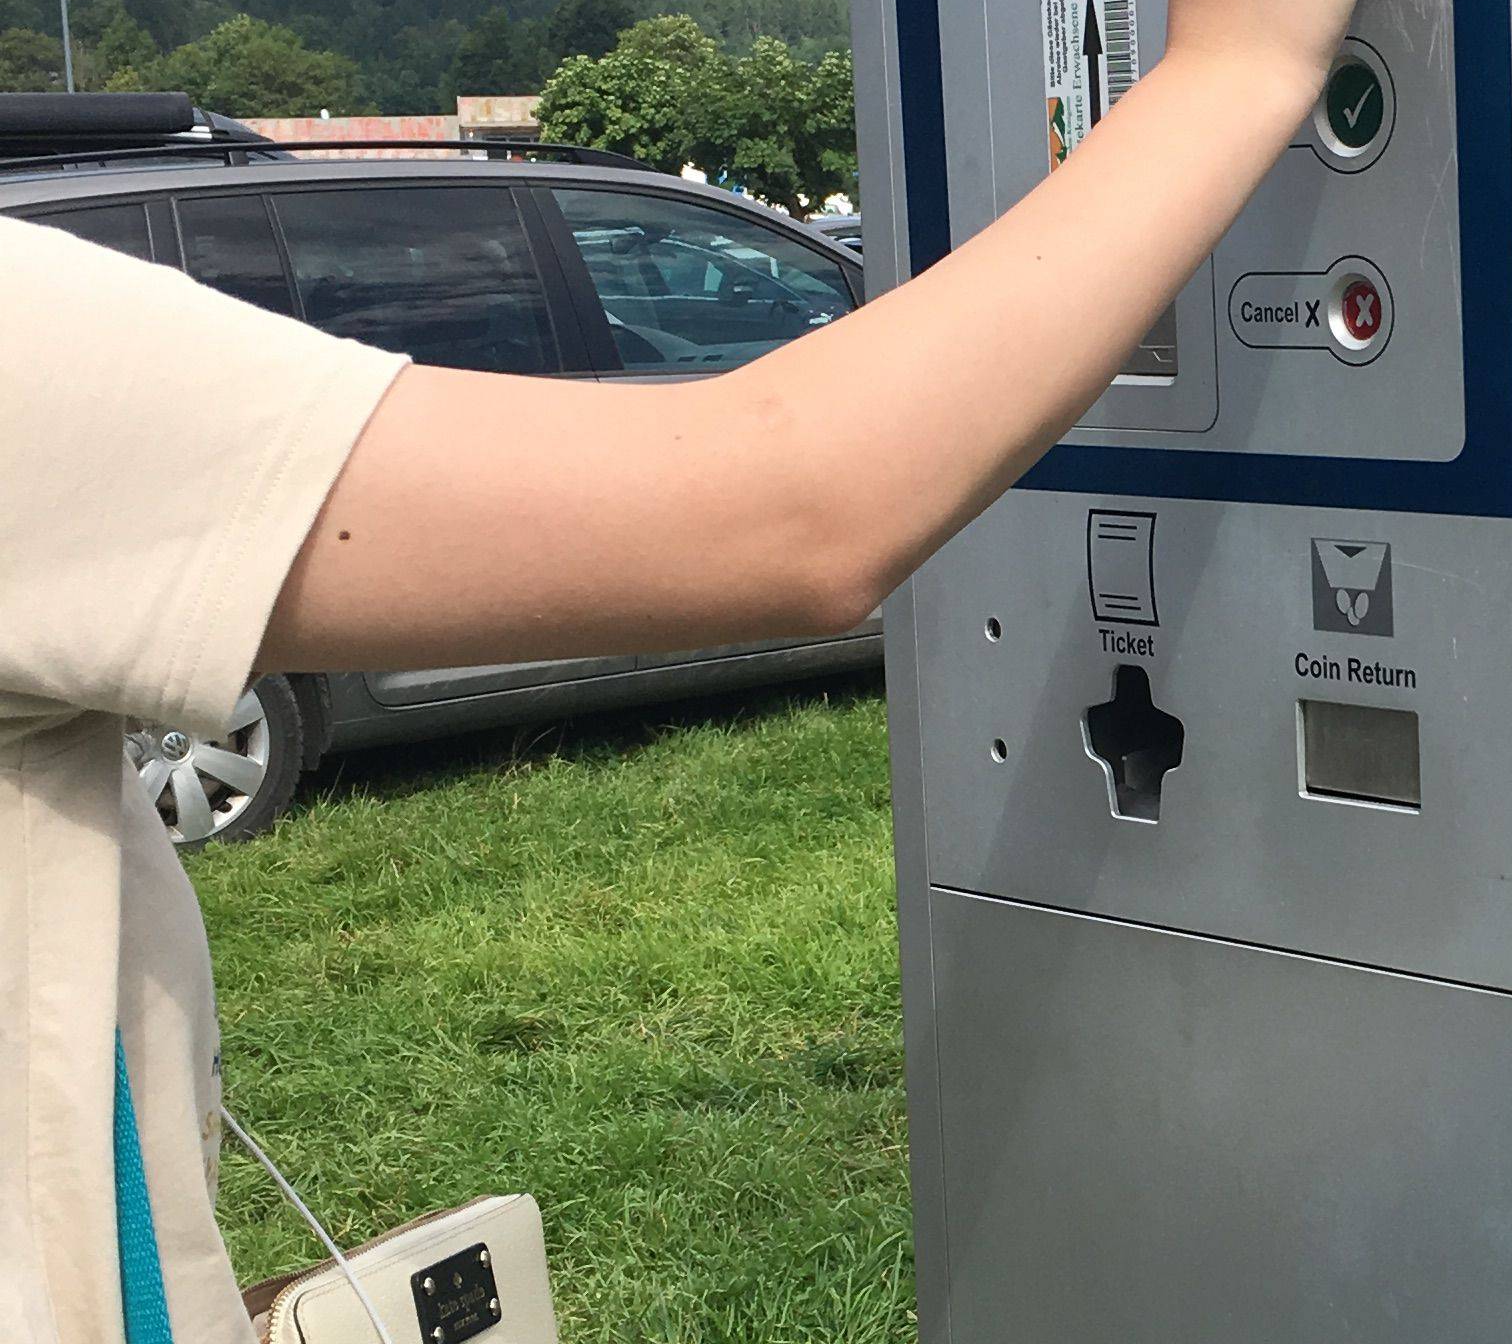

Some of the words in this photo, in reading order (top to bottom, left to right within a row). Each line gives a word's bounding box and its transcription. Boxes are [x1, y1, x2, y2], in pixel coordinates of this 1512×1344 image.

[1071, 2, 1082, 89] Erwachsene
[1075, 95, 1084, 144] ekarte
[1241, 301, 1299, 323] Cancel
[1098, 629, 1154, 657] Ticket
[1295, 652, 1341, 680] Coin
[1348, 658, 1417, 688] Return
